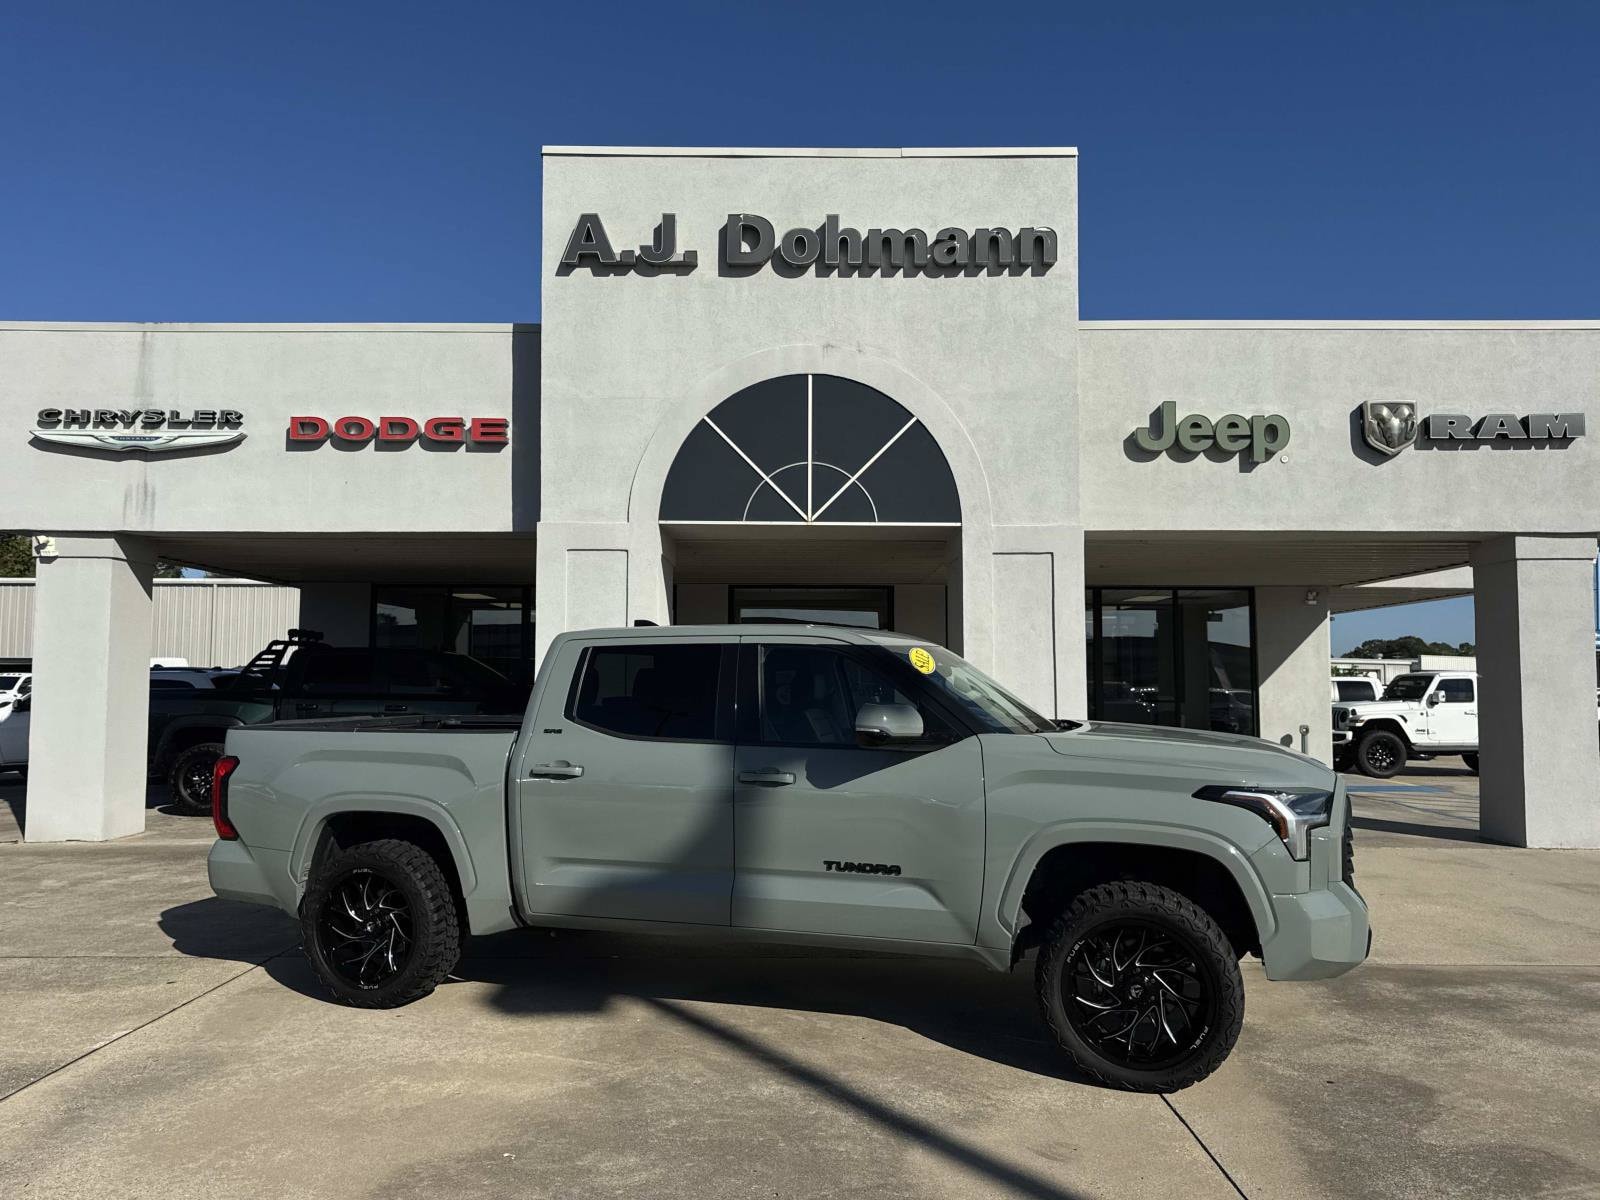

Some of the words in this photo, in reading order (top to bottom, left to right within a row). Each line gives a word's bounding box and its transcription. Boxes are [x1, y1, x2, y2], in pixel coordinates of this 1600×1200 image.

[562, 212, 698, 267] A.J.
[722, 212, 1059, 268] Dohmann
[37, 408, 244, 429] CHRYSLER
[289, 416, 509, 443] DODGE
[1135, 400, 1291, 463] Jeep
[1427, 412, 1587, 440] RAM
[823, 860, 902, 876] TUNDRA
[1066, 939, 1085, 964] FUEL
